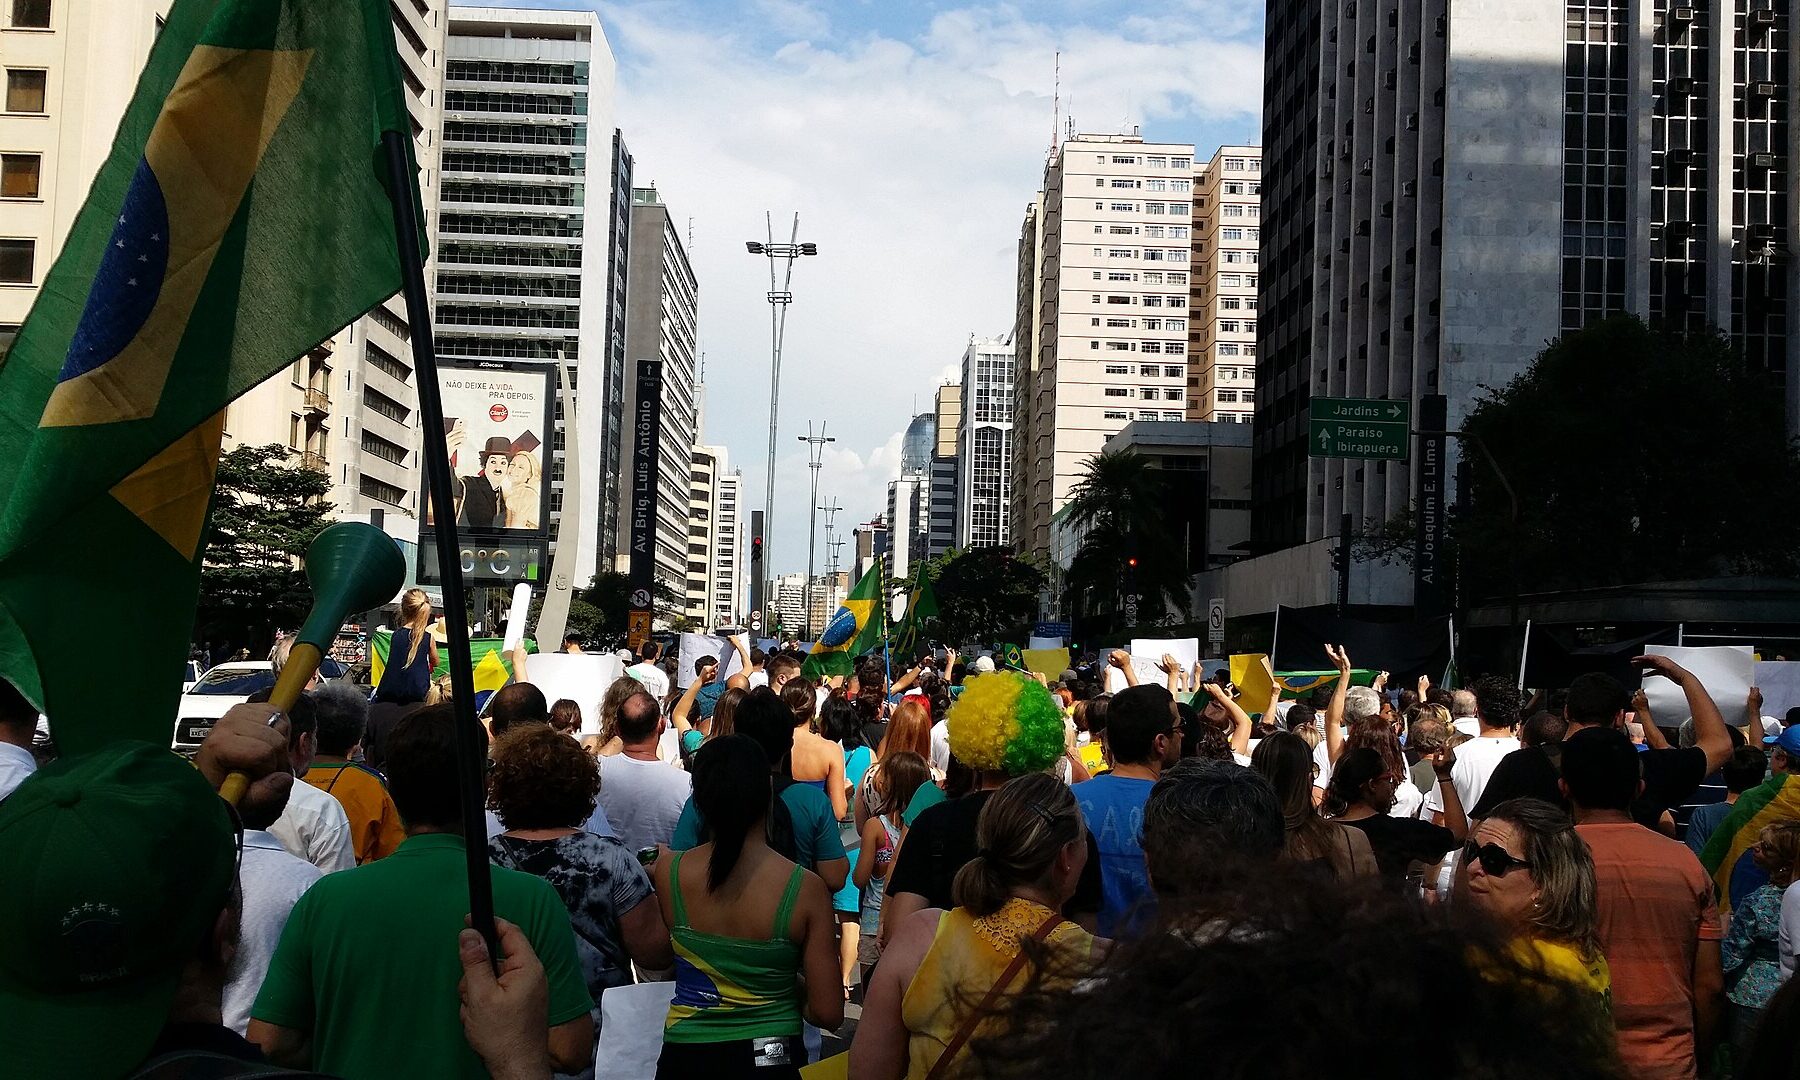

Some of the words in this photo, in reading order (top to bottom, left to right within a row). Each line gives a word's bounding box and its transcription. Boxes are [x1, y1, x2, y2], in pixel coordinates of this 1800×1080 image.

[446, 380, 462, 389] NÃO
[465, 381, 487, 390] DEIXE
[489, 391, 505, 399] PRA
[507, 392, 536, 401] DEPOIS.
[1333, 405, 1379, 416] Jardins
[637, 400, 651, 457] Antônio
[1337, 442, 1399, 455] Ibirapuera
[1424, 439, 1436, 475] Lima
[636, 462, 649, 491] Luís
[1424, 480, 1436, 492] E.
[635, 496, 651, 528] Brig.
[1422, 497, 1436, 560] Joaquim
[634, 533, 646, 553] Av.
[1422, 566, 1433, 584] Al.
